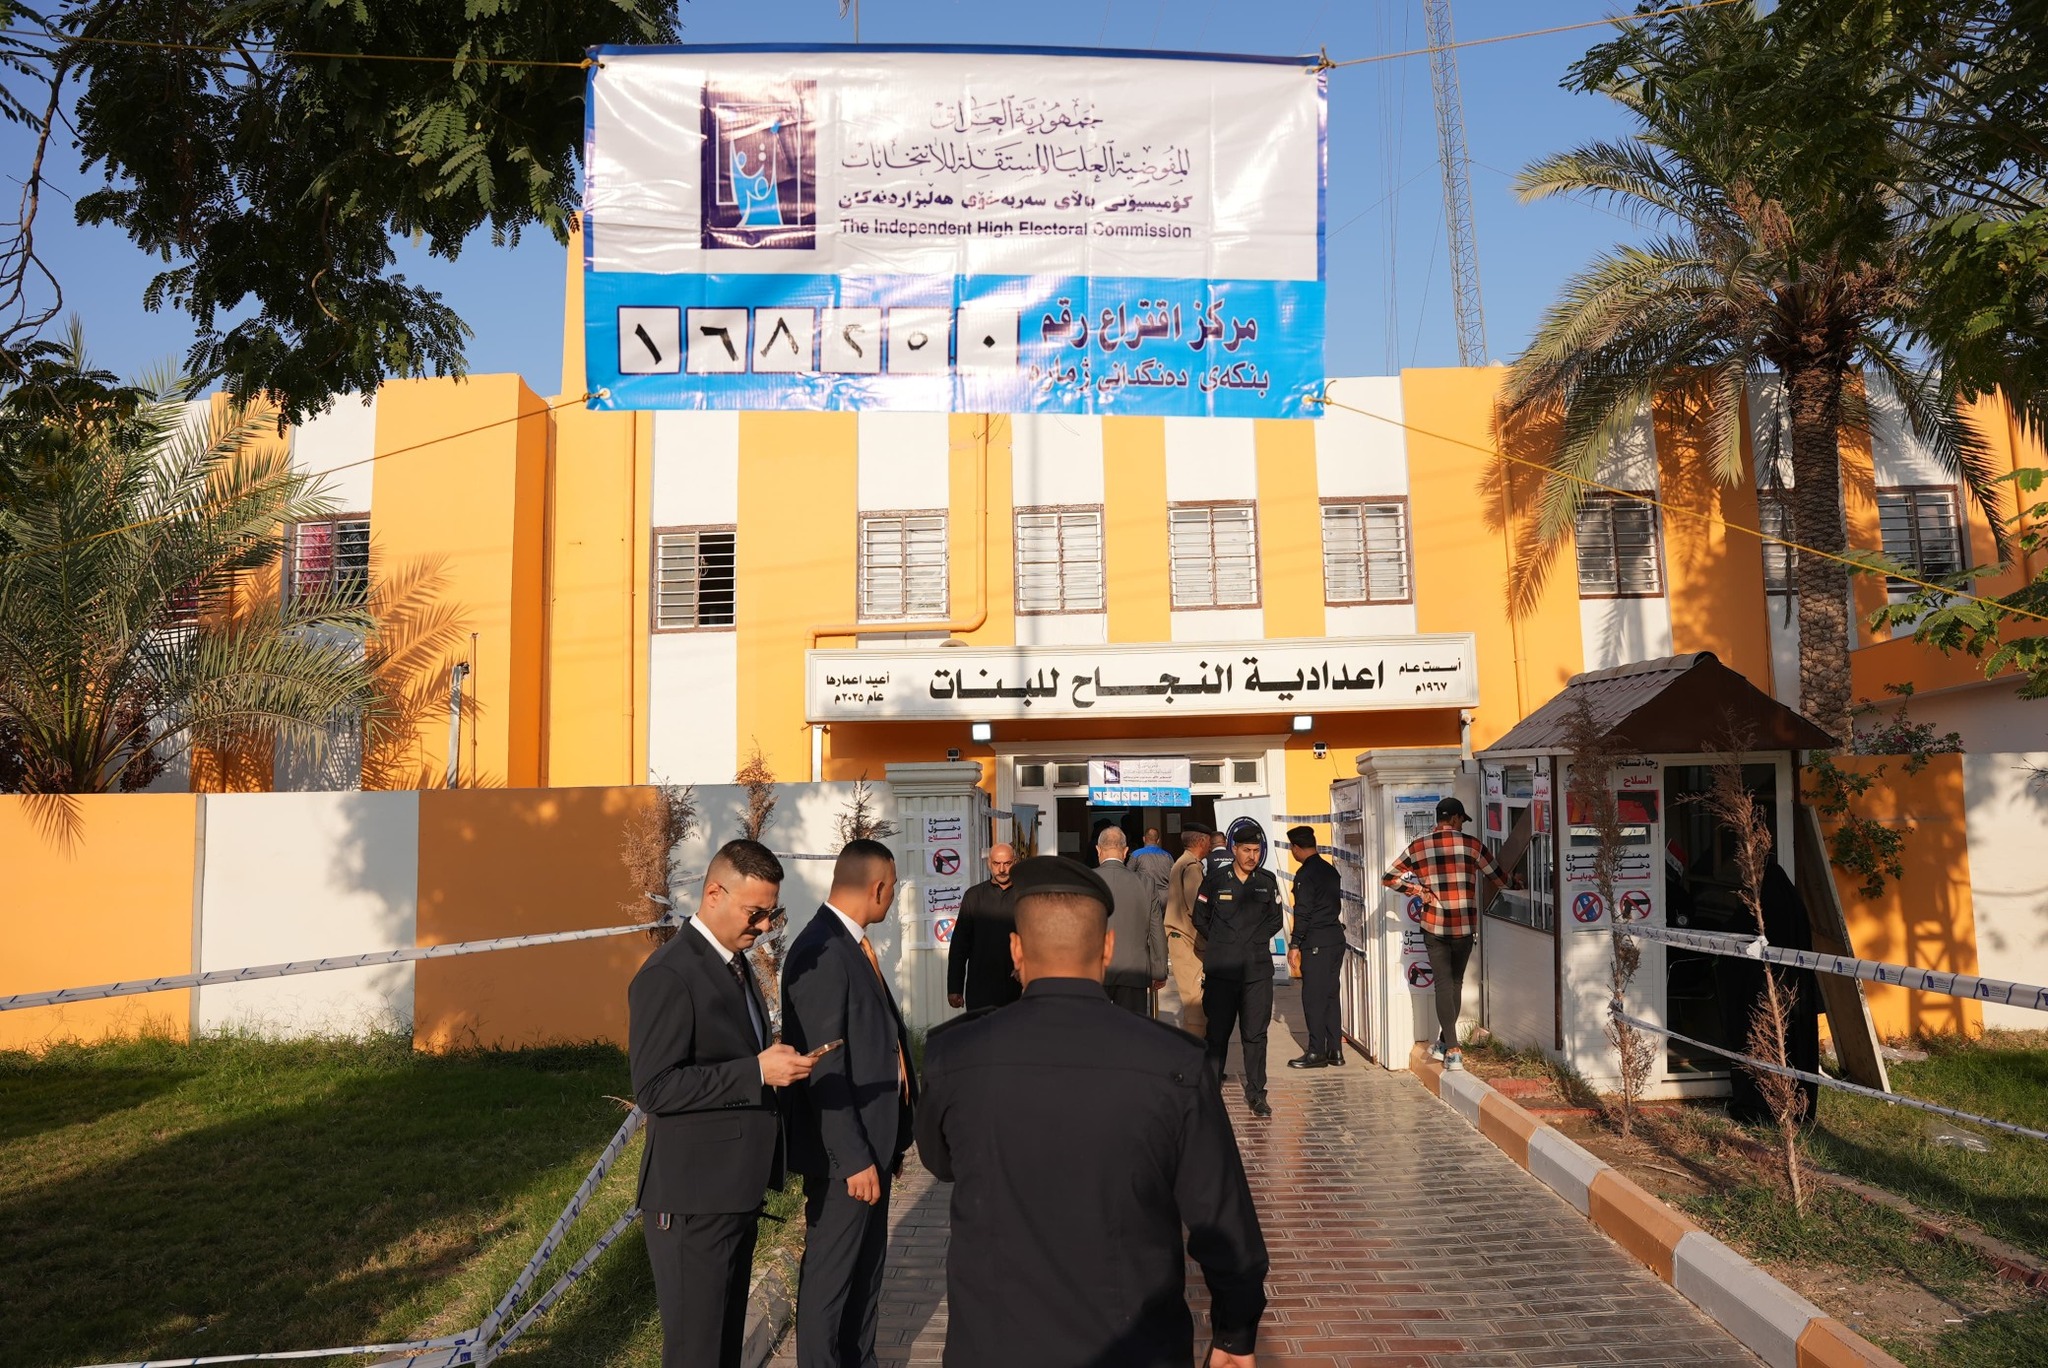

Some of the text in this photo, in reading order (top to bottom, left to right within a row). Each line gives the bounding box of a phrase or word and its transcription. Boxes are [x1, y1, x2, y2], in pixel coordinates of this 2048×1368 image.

[840, 218, 1192, 238] The Independent High Electoral Commission
[1041, 298, 1257, 351] مركز اقتراع رقم
[1398, 661, 1420, 676] عام
[929, 656, 1384, 709] اعدادية النجاح للبنات
[867, 691, 884, 705] عام
